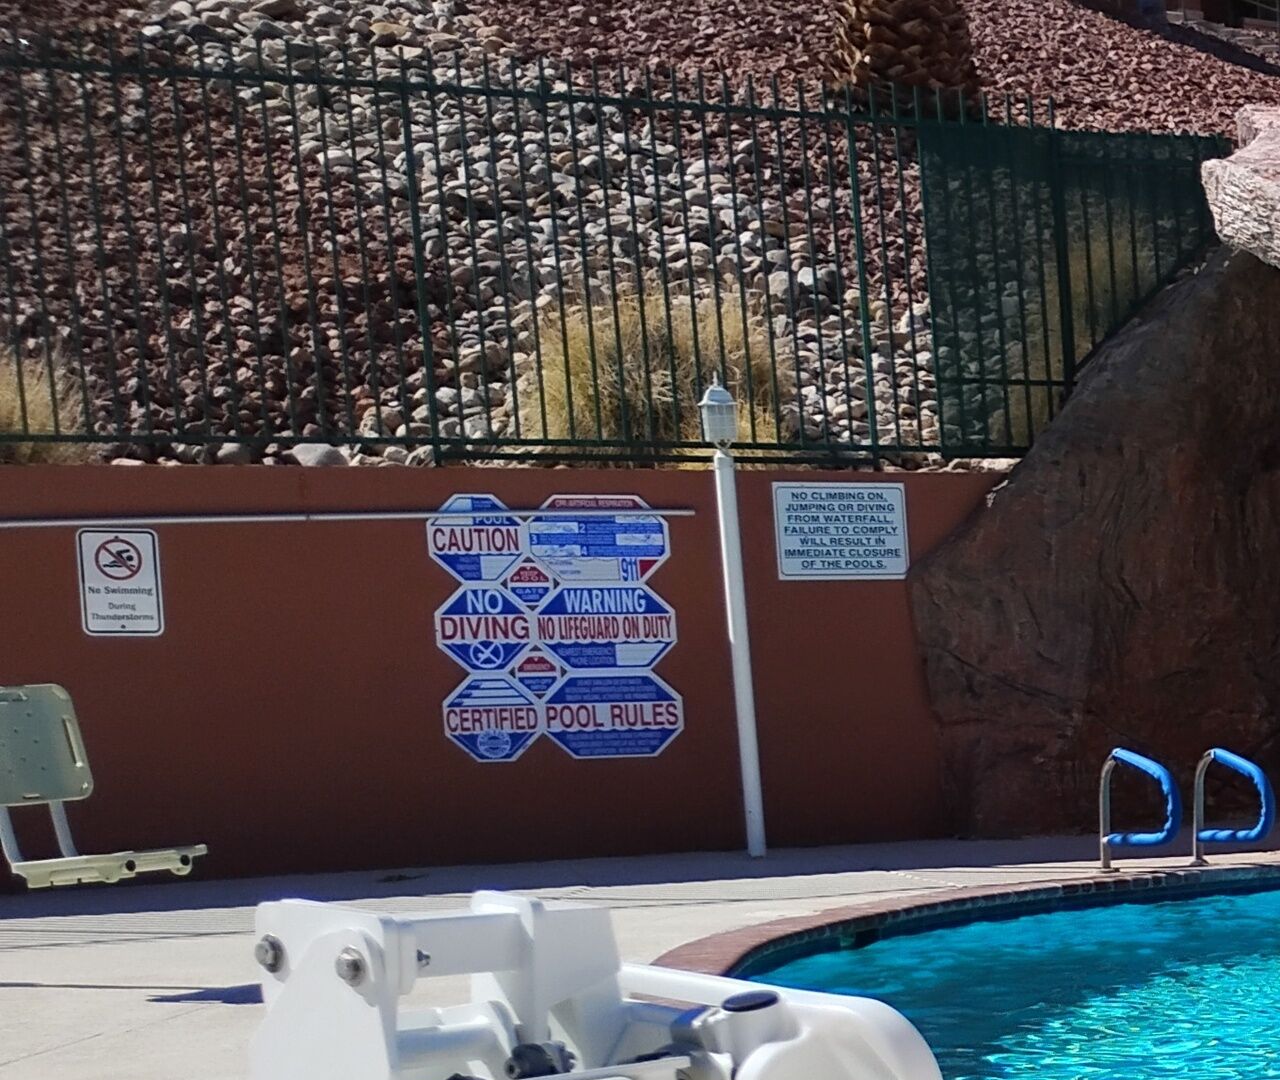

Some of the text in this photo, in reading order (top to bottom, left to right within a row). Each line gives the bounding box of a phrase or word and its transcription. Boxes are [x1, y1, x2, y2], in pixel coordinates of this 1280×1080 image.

[791, 492, 807, 500] NO
[811, 492, 864, 500] CLIMBING
[787, 515, 820, 523] FROM
[784, 526, 897, 534] FAILURE TO COMPLY
[433, 528, 520, 552] CAUTION
[800, 537, 886, 546] WILL RESULT IN
[784, 549, 901, 557] IMMEDIATE CLOSURE
[621, 559, 638, 581] 911
[801, 560, 817, 568] OF
[820, 560, 841, 568] THE
[88, 586, 153, 596] No Swimming
[108, 602, 136, 610] During
[466, 590, 503, 614] NO
[563, 589, 646, 613] WARNING
[440, 616, 530, 640] DIVING
[538, 616, 672, 640] NO LIFEGUARD ON DUTY
[446, 708, 537, 732] CERTIFIED
[546, 703, 678, 728] POOL RULES
